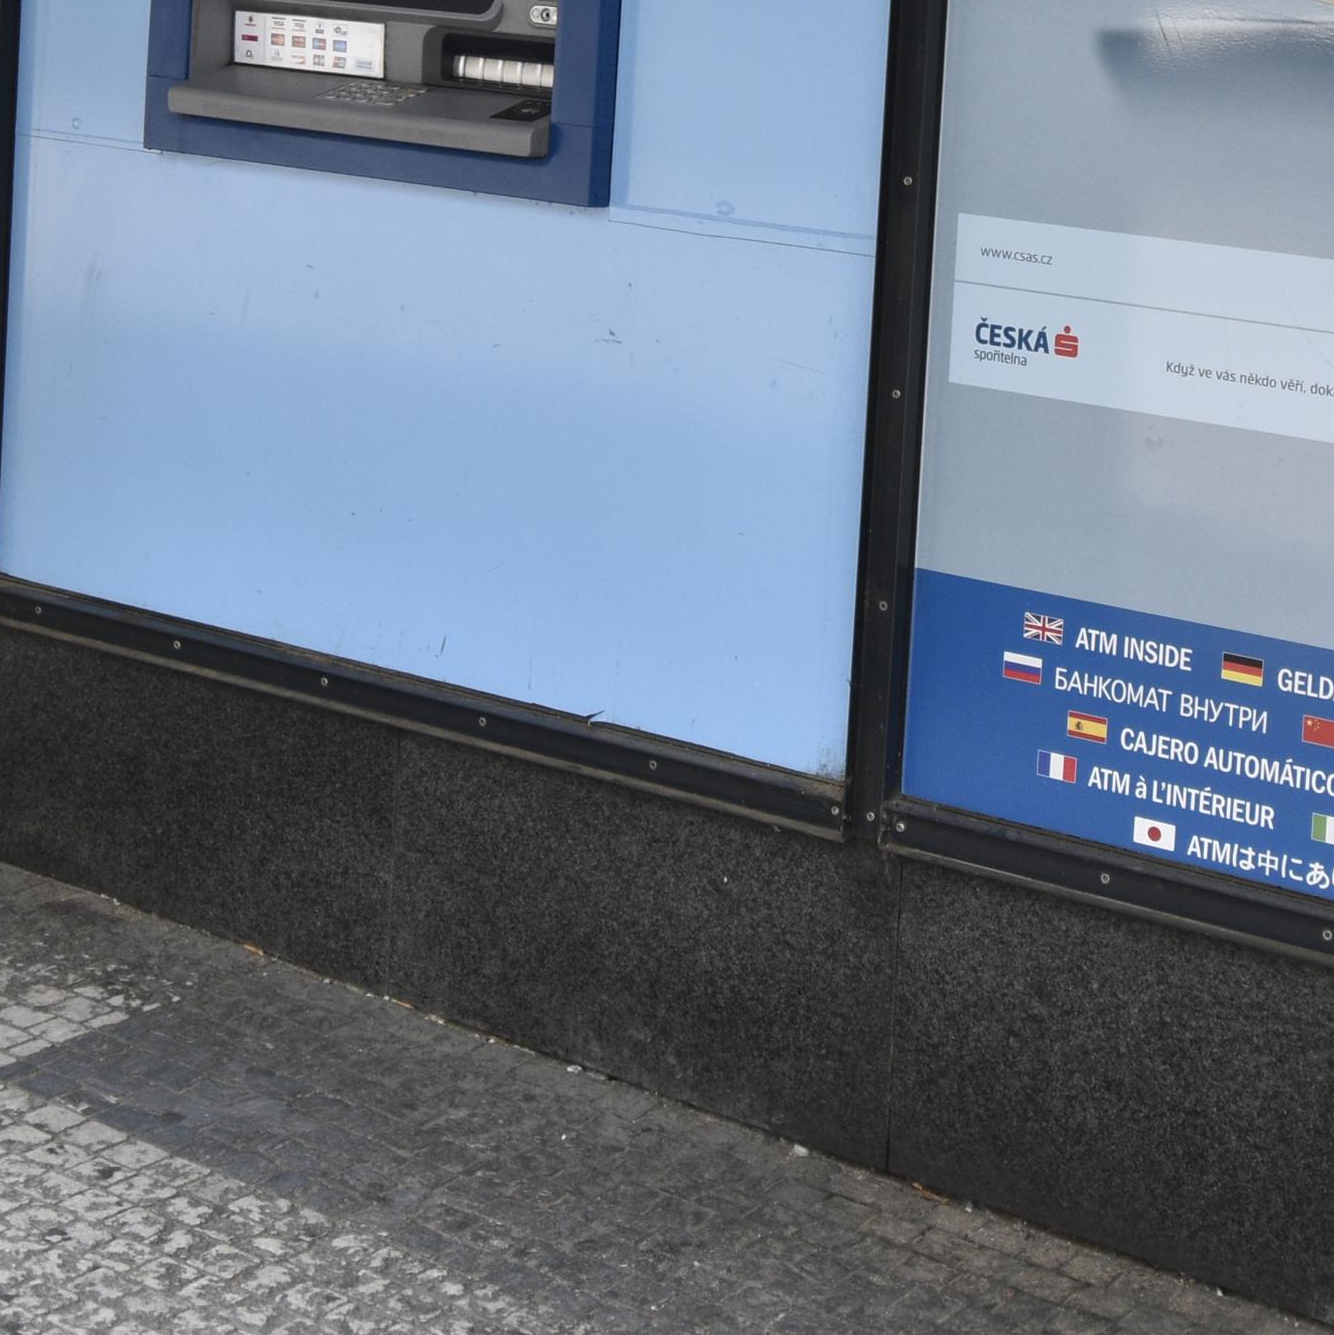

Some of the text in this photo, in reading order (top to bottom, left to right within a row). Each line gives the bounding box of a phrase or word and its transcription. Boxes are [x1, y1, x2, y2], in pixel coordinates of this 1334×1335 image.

[979, 246, 1054, 266] www.csas.cz
[973, 317, 1050, 355] ČESKÁ
[973, 347, 1028, 367] spořitelna
[1166, 361, 1195, 377] Když
[1197, 366, 1213, 378] ve
[1215, 368, 1237, 382] vás
[1239, 372, 1277, 388] někdo
[1280, 378, 1307, 394] věří,
[1074, 627, 1194, 672] ATM INSIDE
[1053, 666, 1269, 735] БАНКОМАТ ВНУТРИ
[1119, 727, 1200, 765] CAJERO
[1087, 766, 1276, 830] ATM à L'INTÉRIEUR
